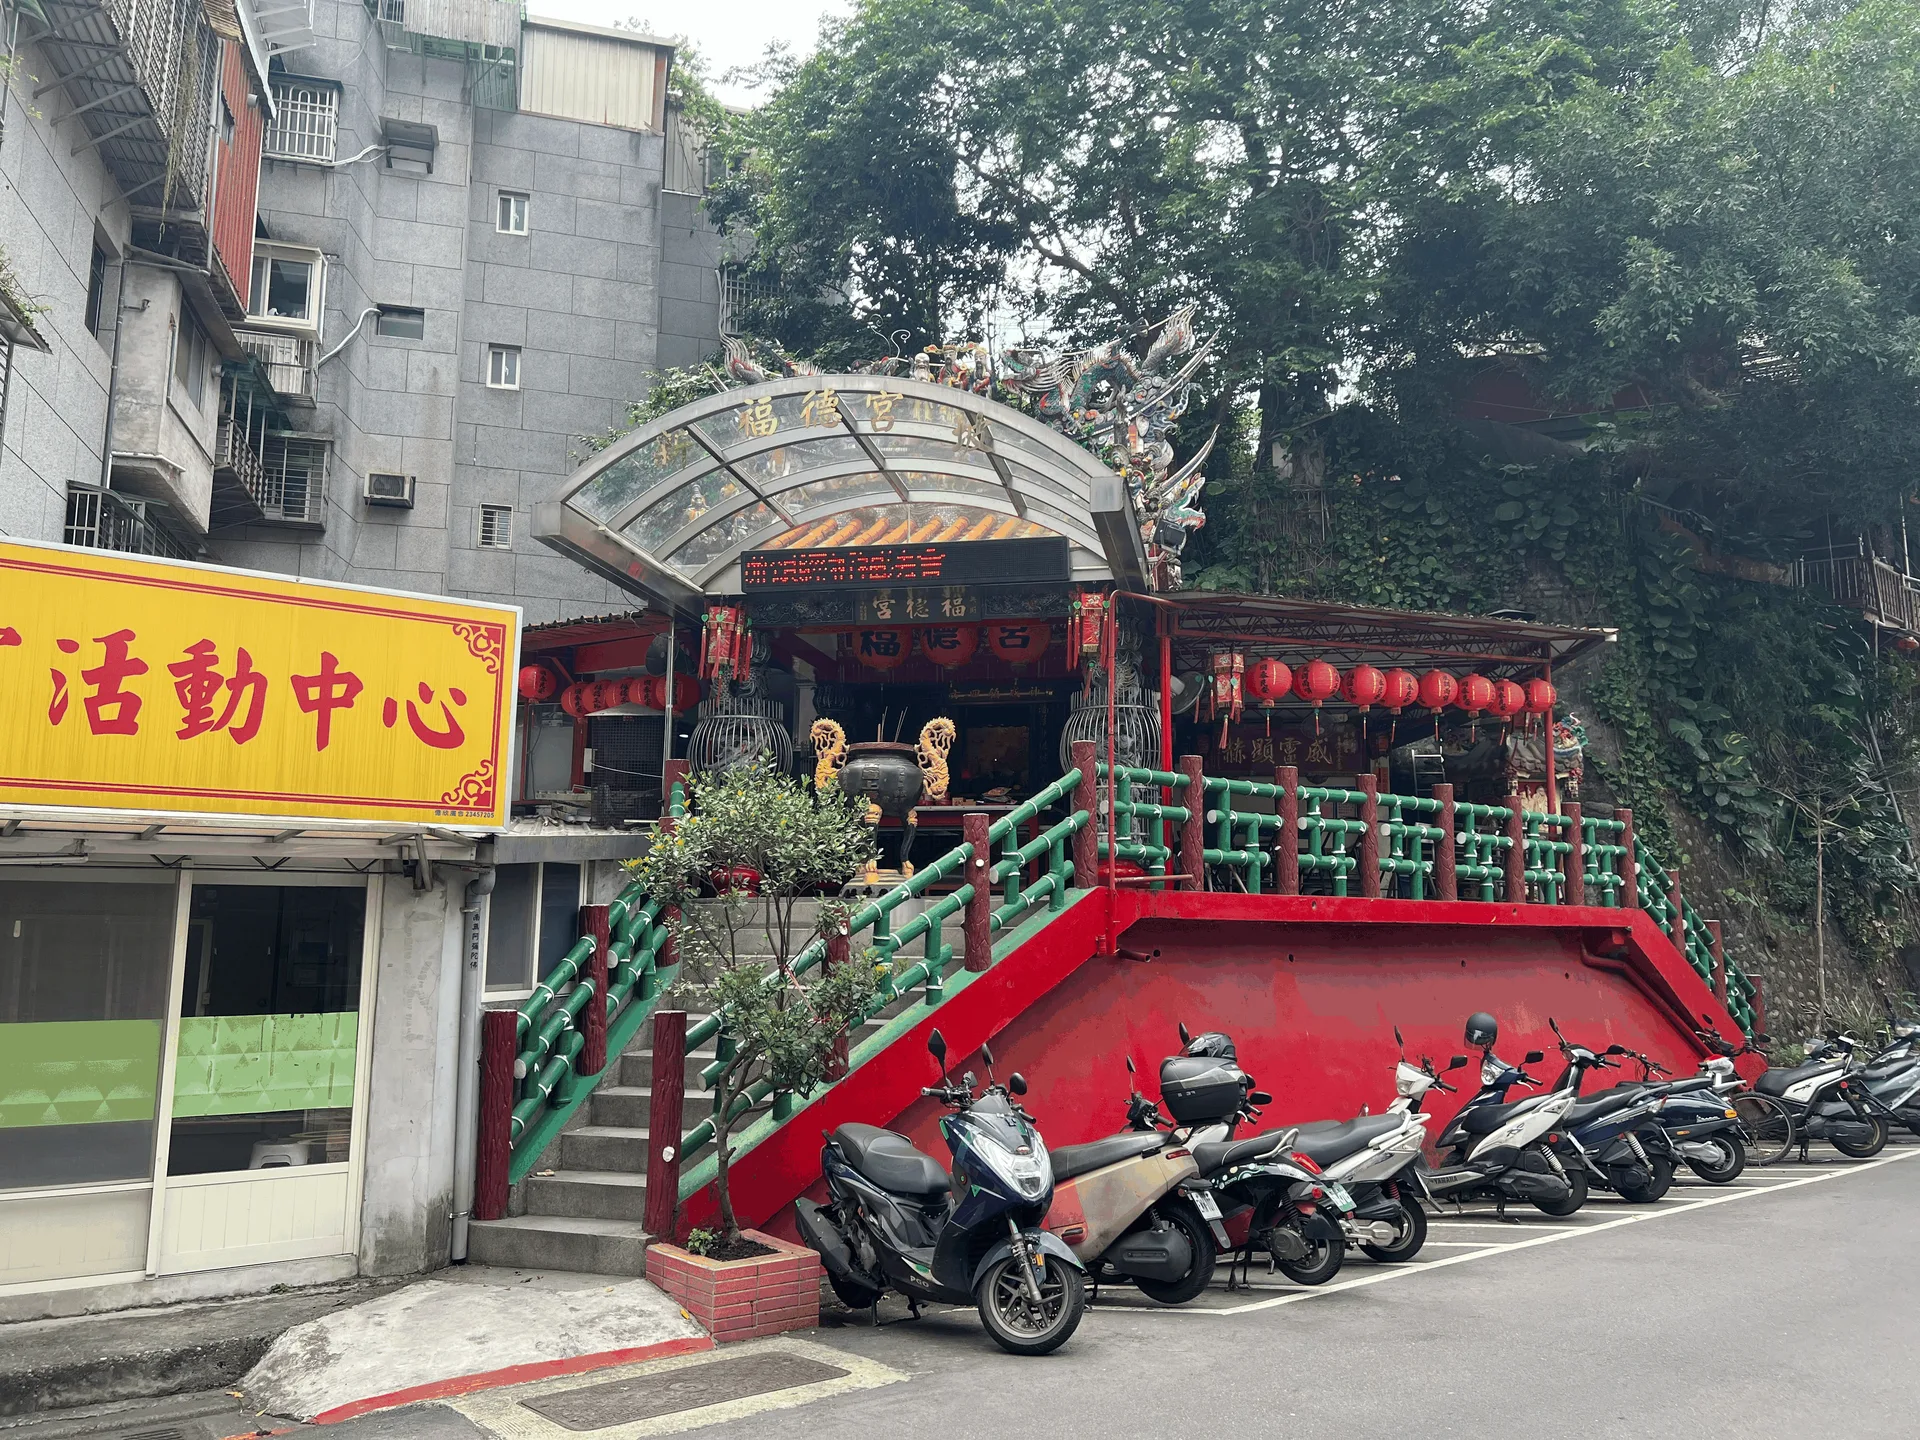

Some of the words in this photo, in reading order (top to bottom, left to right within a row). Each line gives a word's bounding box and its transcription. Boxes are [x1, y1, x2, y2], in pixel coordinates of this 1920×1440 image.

[739, 388, 904, 438] 福德宮
[872, 597, 966, 620] 福德宮
[0, 627, 468, 752] 活動中心
[1434, 1176, 1458, 1184] YAMAHA
[909, 1275, 930, 1288] PGO
